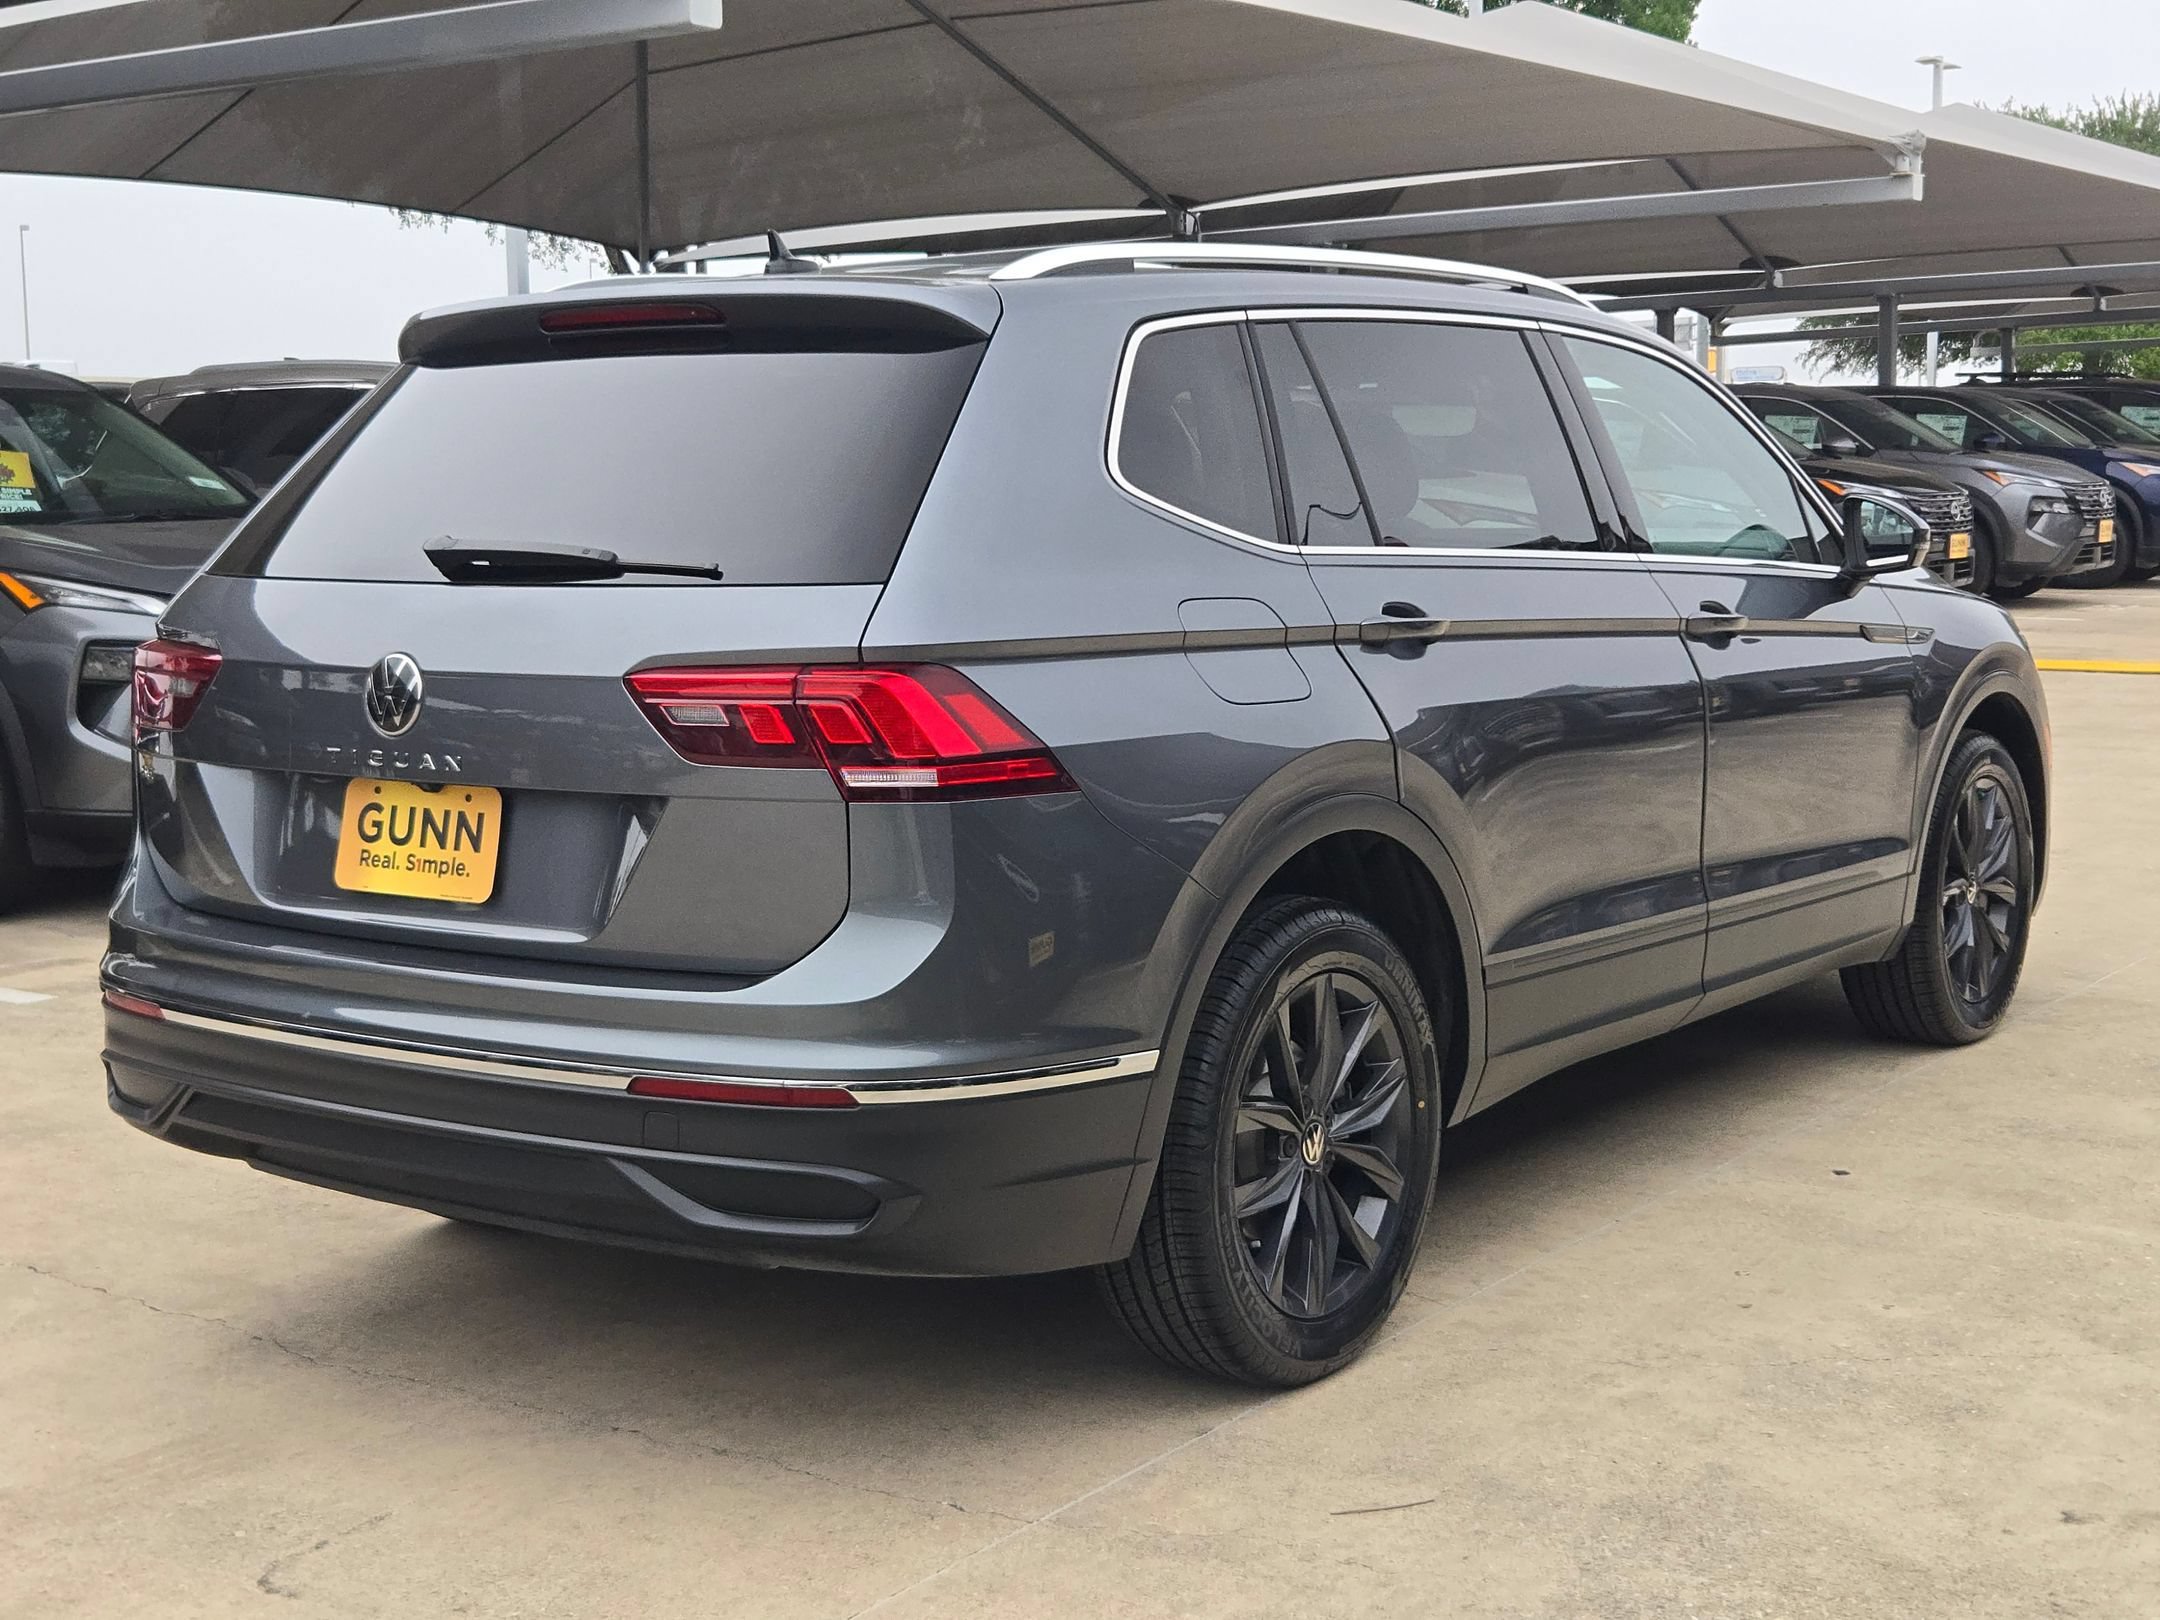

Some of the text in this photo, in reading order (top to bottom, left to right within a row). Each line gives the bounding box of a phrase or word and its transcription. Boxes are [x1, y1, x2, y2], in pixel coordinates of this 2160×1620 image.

[326, 746, 463, 772] TIGUAN
[357, 801, 485, 854] GUNN
[359, 848, 400, 870] Real.
